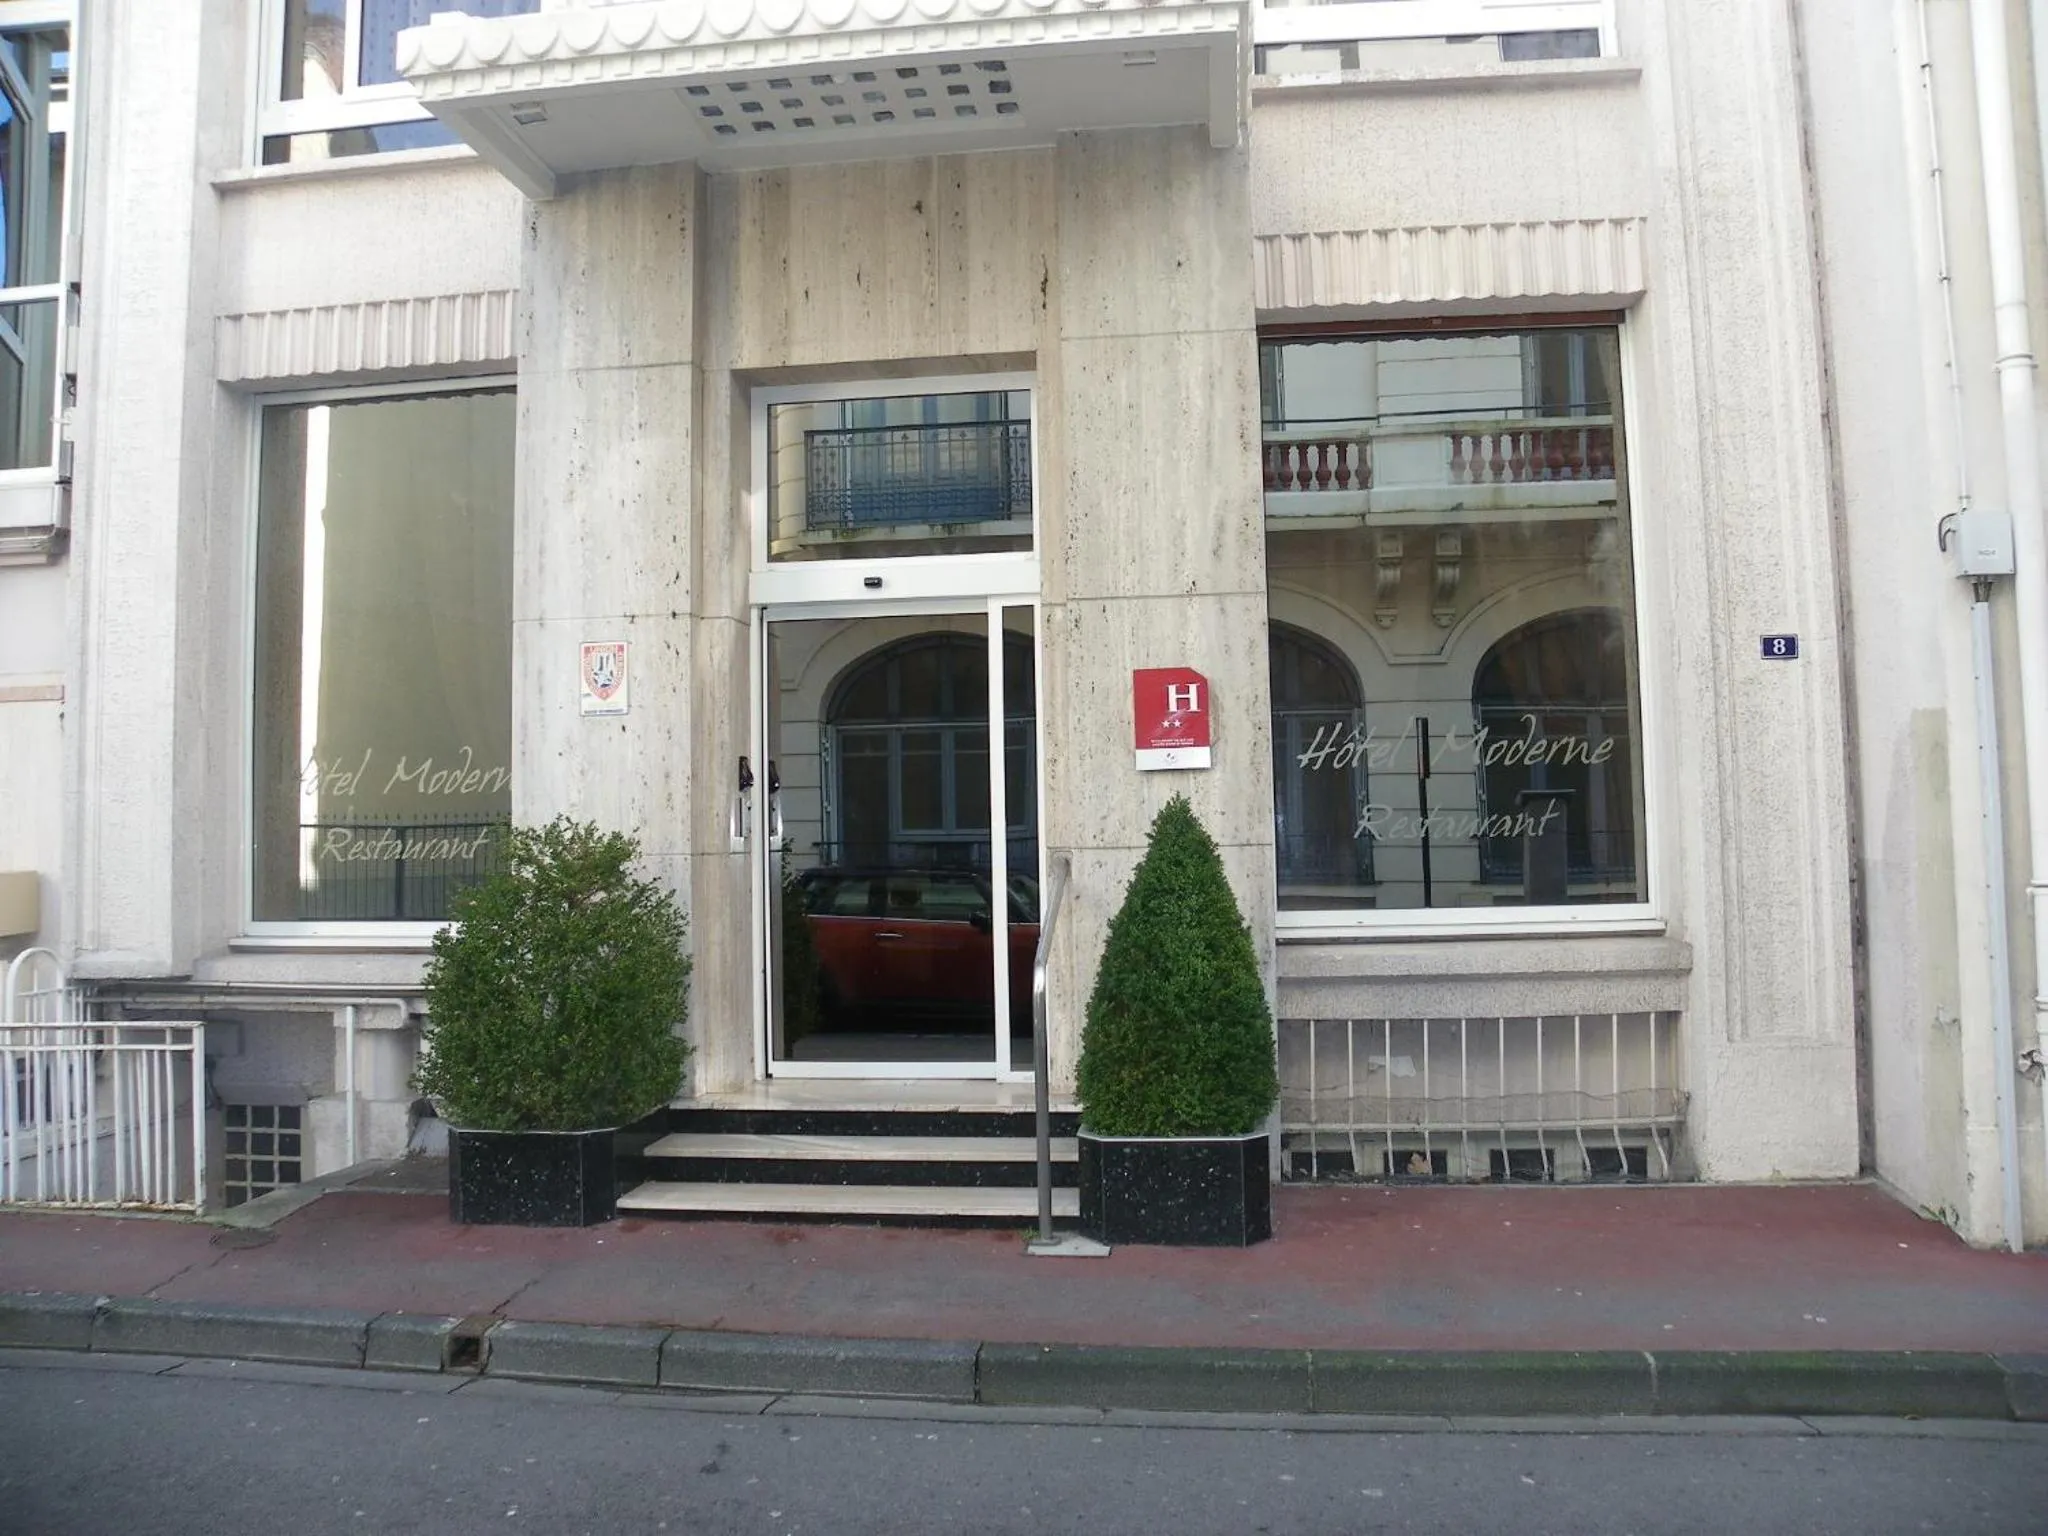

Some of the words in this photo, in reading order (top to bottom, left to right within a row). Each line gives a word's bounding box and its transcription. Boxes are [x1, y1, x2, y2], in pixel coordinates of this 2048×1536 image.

[1773, 638, 1786, 655] 8
[1167, 683, 1201, 712] H
[1296, 716, 1414, 770] Hôtel
[1431, 713, 1615, 767] Moderne
[384, 744, 512, 794] Modern
[1353, 798, 1560, 841] Restaurant
[320, 827, 490, 862] Restaurant
